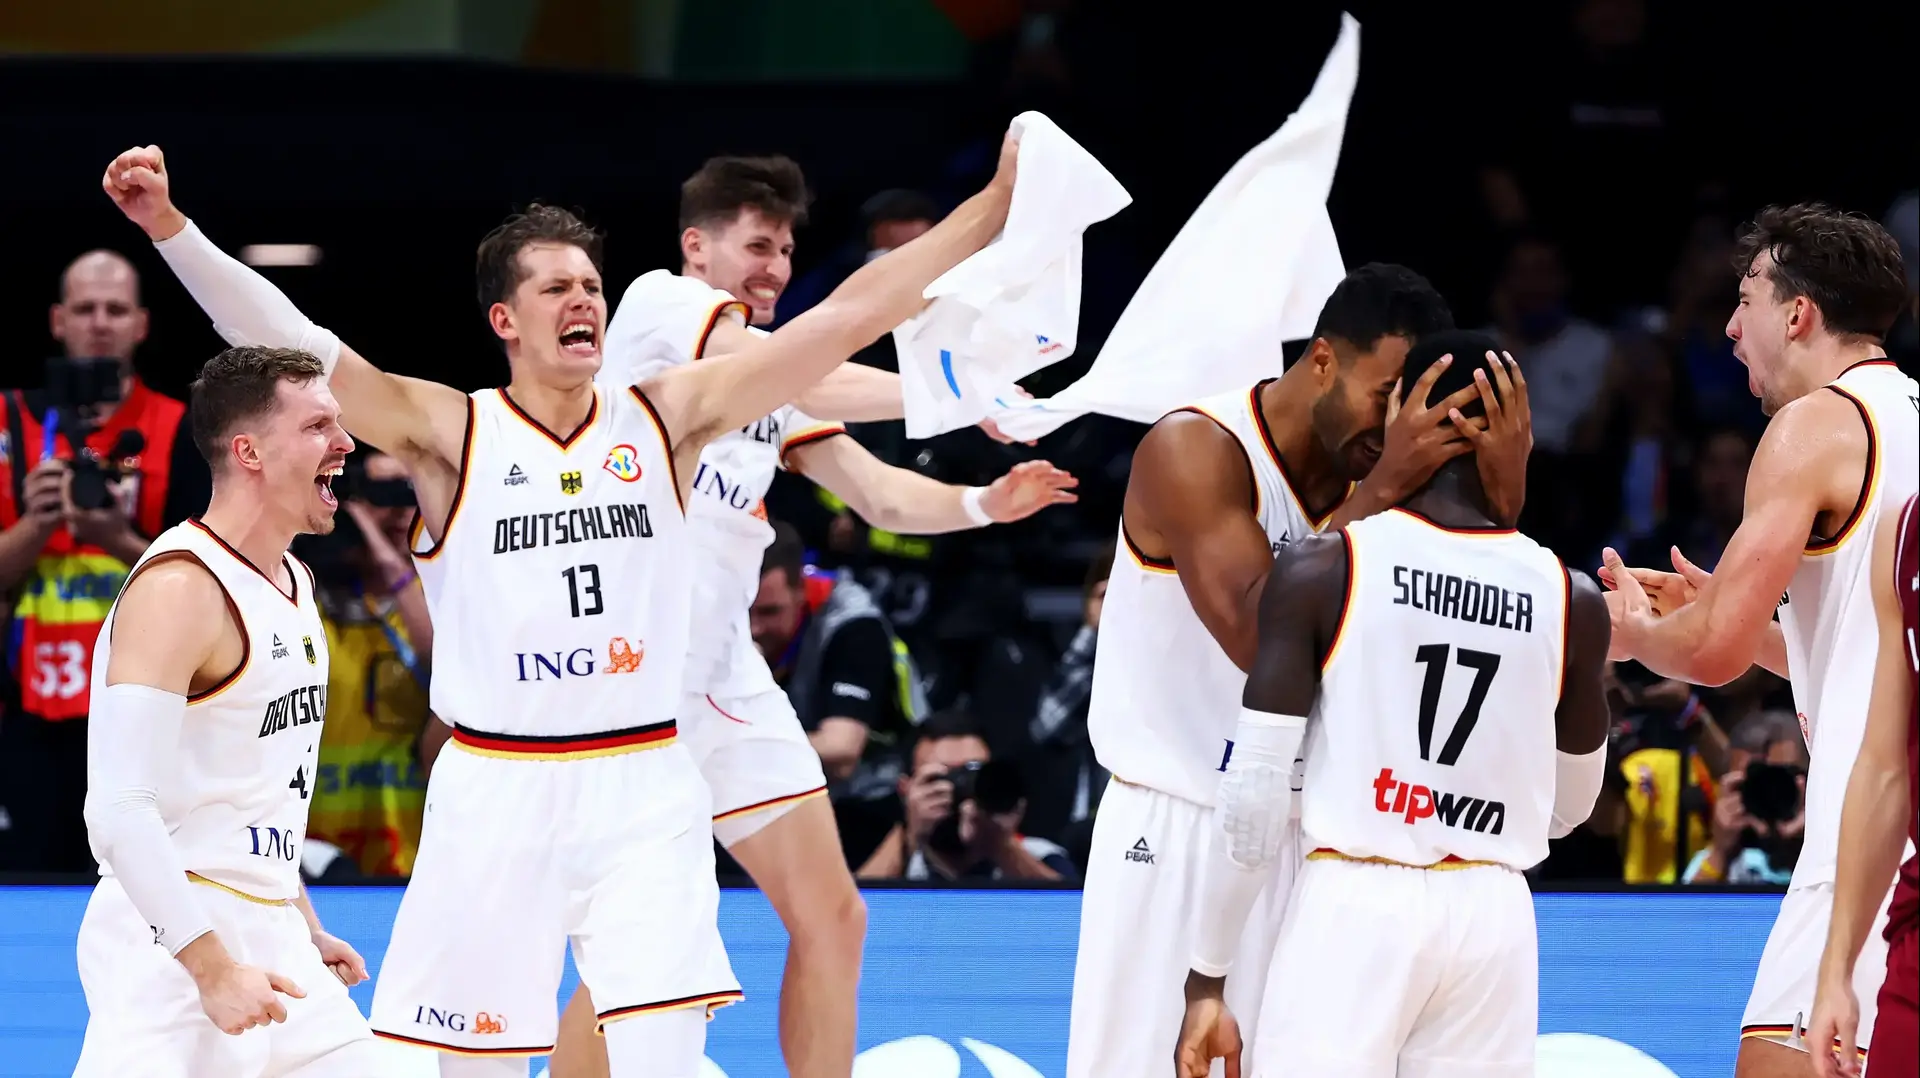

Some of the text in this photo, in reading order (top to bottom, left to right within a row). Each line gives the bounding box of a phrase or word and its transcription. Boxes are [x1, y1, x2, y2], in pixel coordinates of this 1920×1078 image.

[504, 475, 530, 487] PEAK
[693, 461, 751, 510] ING
[493, 503, 654, 555] DEUTSCHLAND
[561, 563, 604, 618] 13
[1393, 564, 1533, 633] SCHRÖDER
[514, 647, 596, 682] ING
[1414, 643, 1502, 767] 17
[1373, 767, 1506, 836] tipwin
[246, 824, 295, 862] ING
[1125, 849, 1157, 866] PEAK
[414, 1004, 466, 1032] ING
